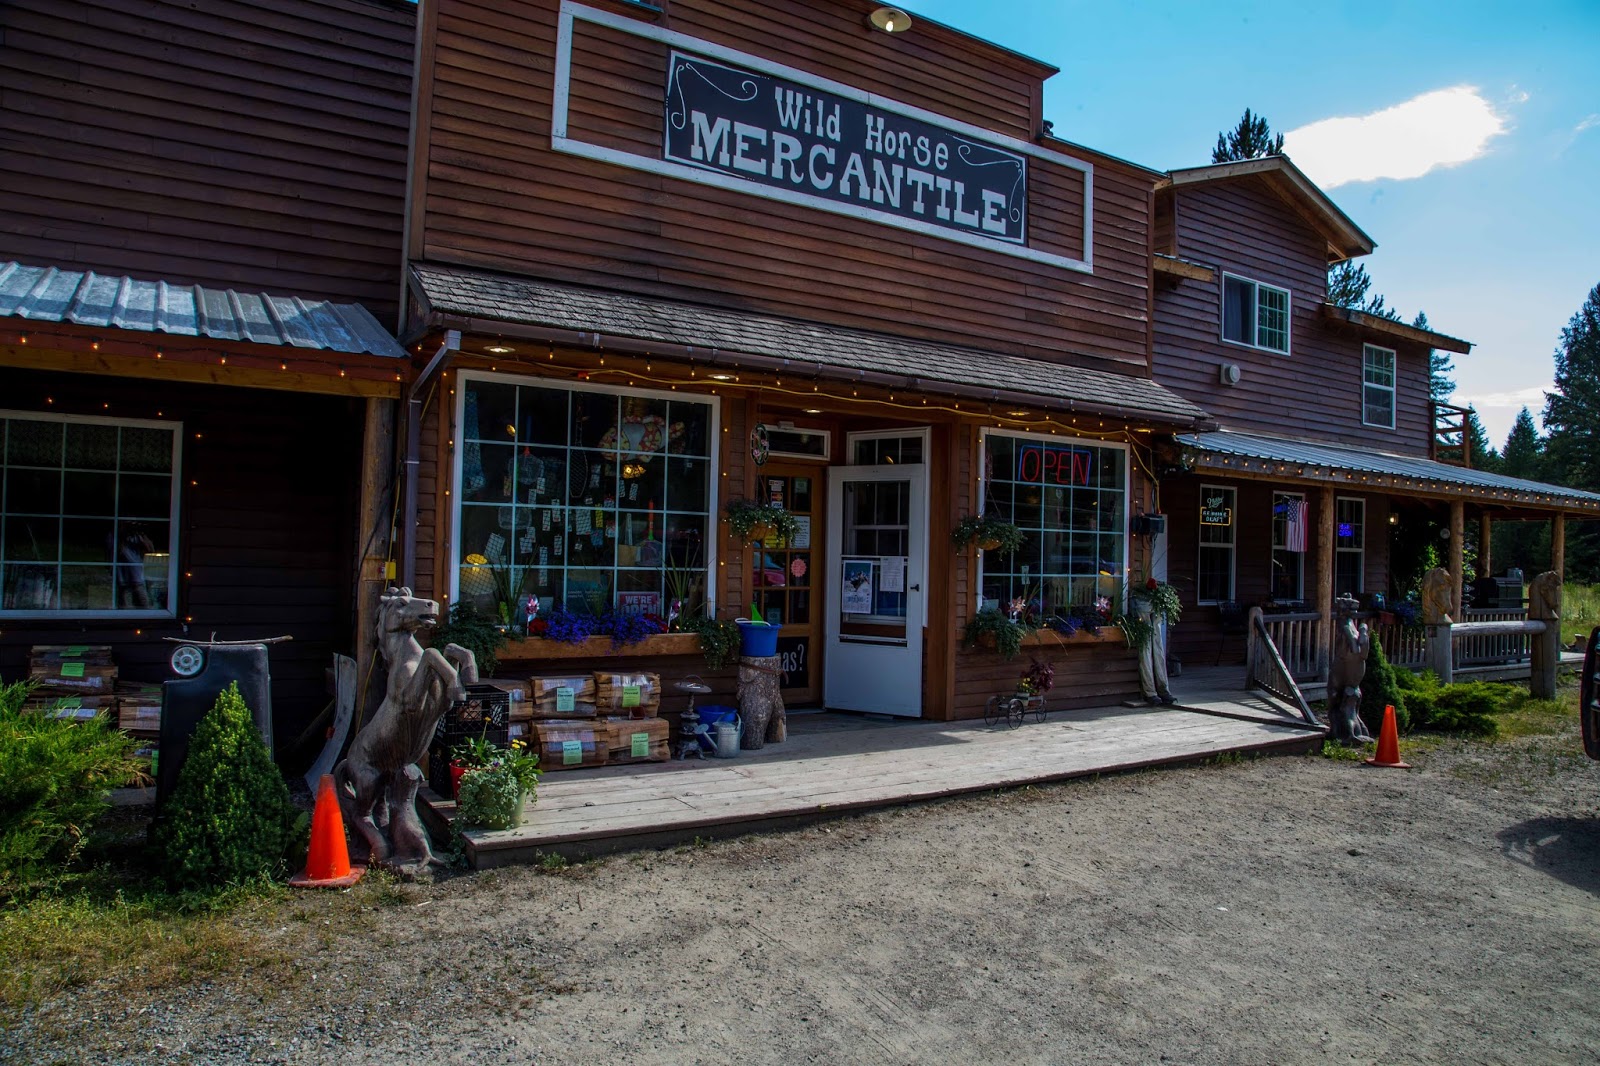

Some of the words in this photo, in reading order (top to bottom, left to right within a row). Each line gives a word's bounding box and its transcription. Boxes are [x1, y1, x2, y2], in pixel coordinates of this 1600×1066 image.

[775, 87, 841, 142] Wild
[865, 114, 949, 170] Horse
[690, 110, 1006, 235] MERCANTILE
[1021, 449, 1088, 485] OPEN
[621, 604, 657, 617] OPEN
[625, 595, 652, 604] WE'RE
[782, 643, 804, 672] as?
